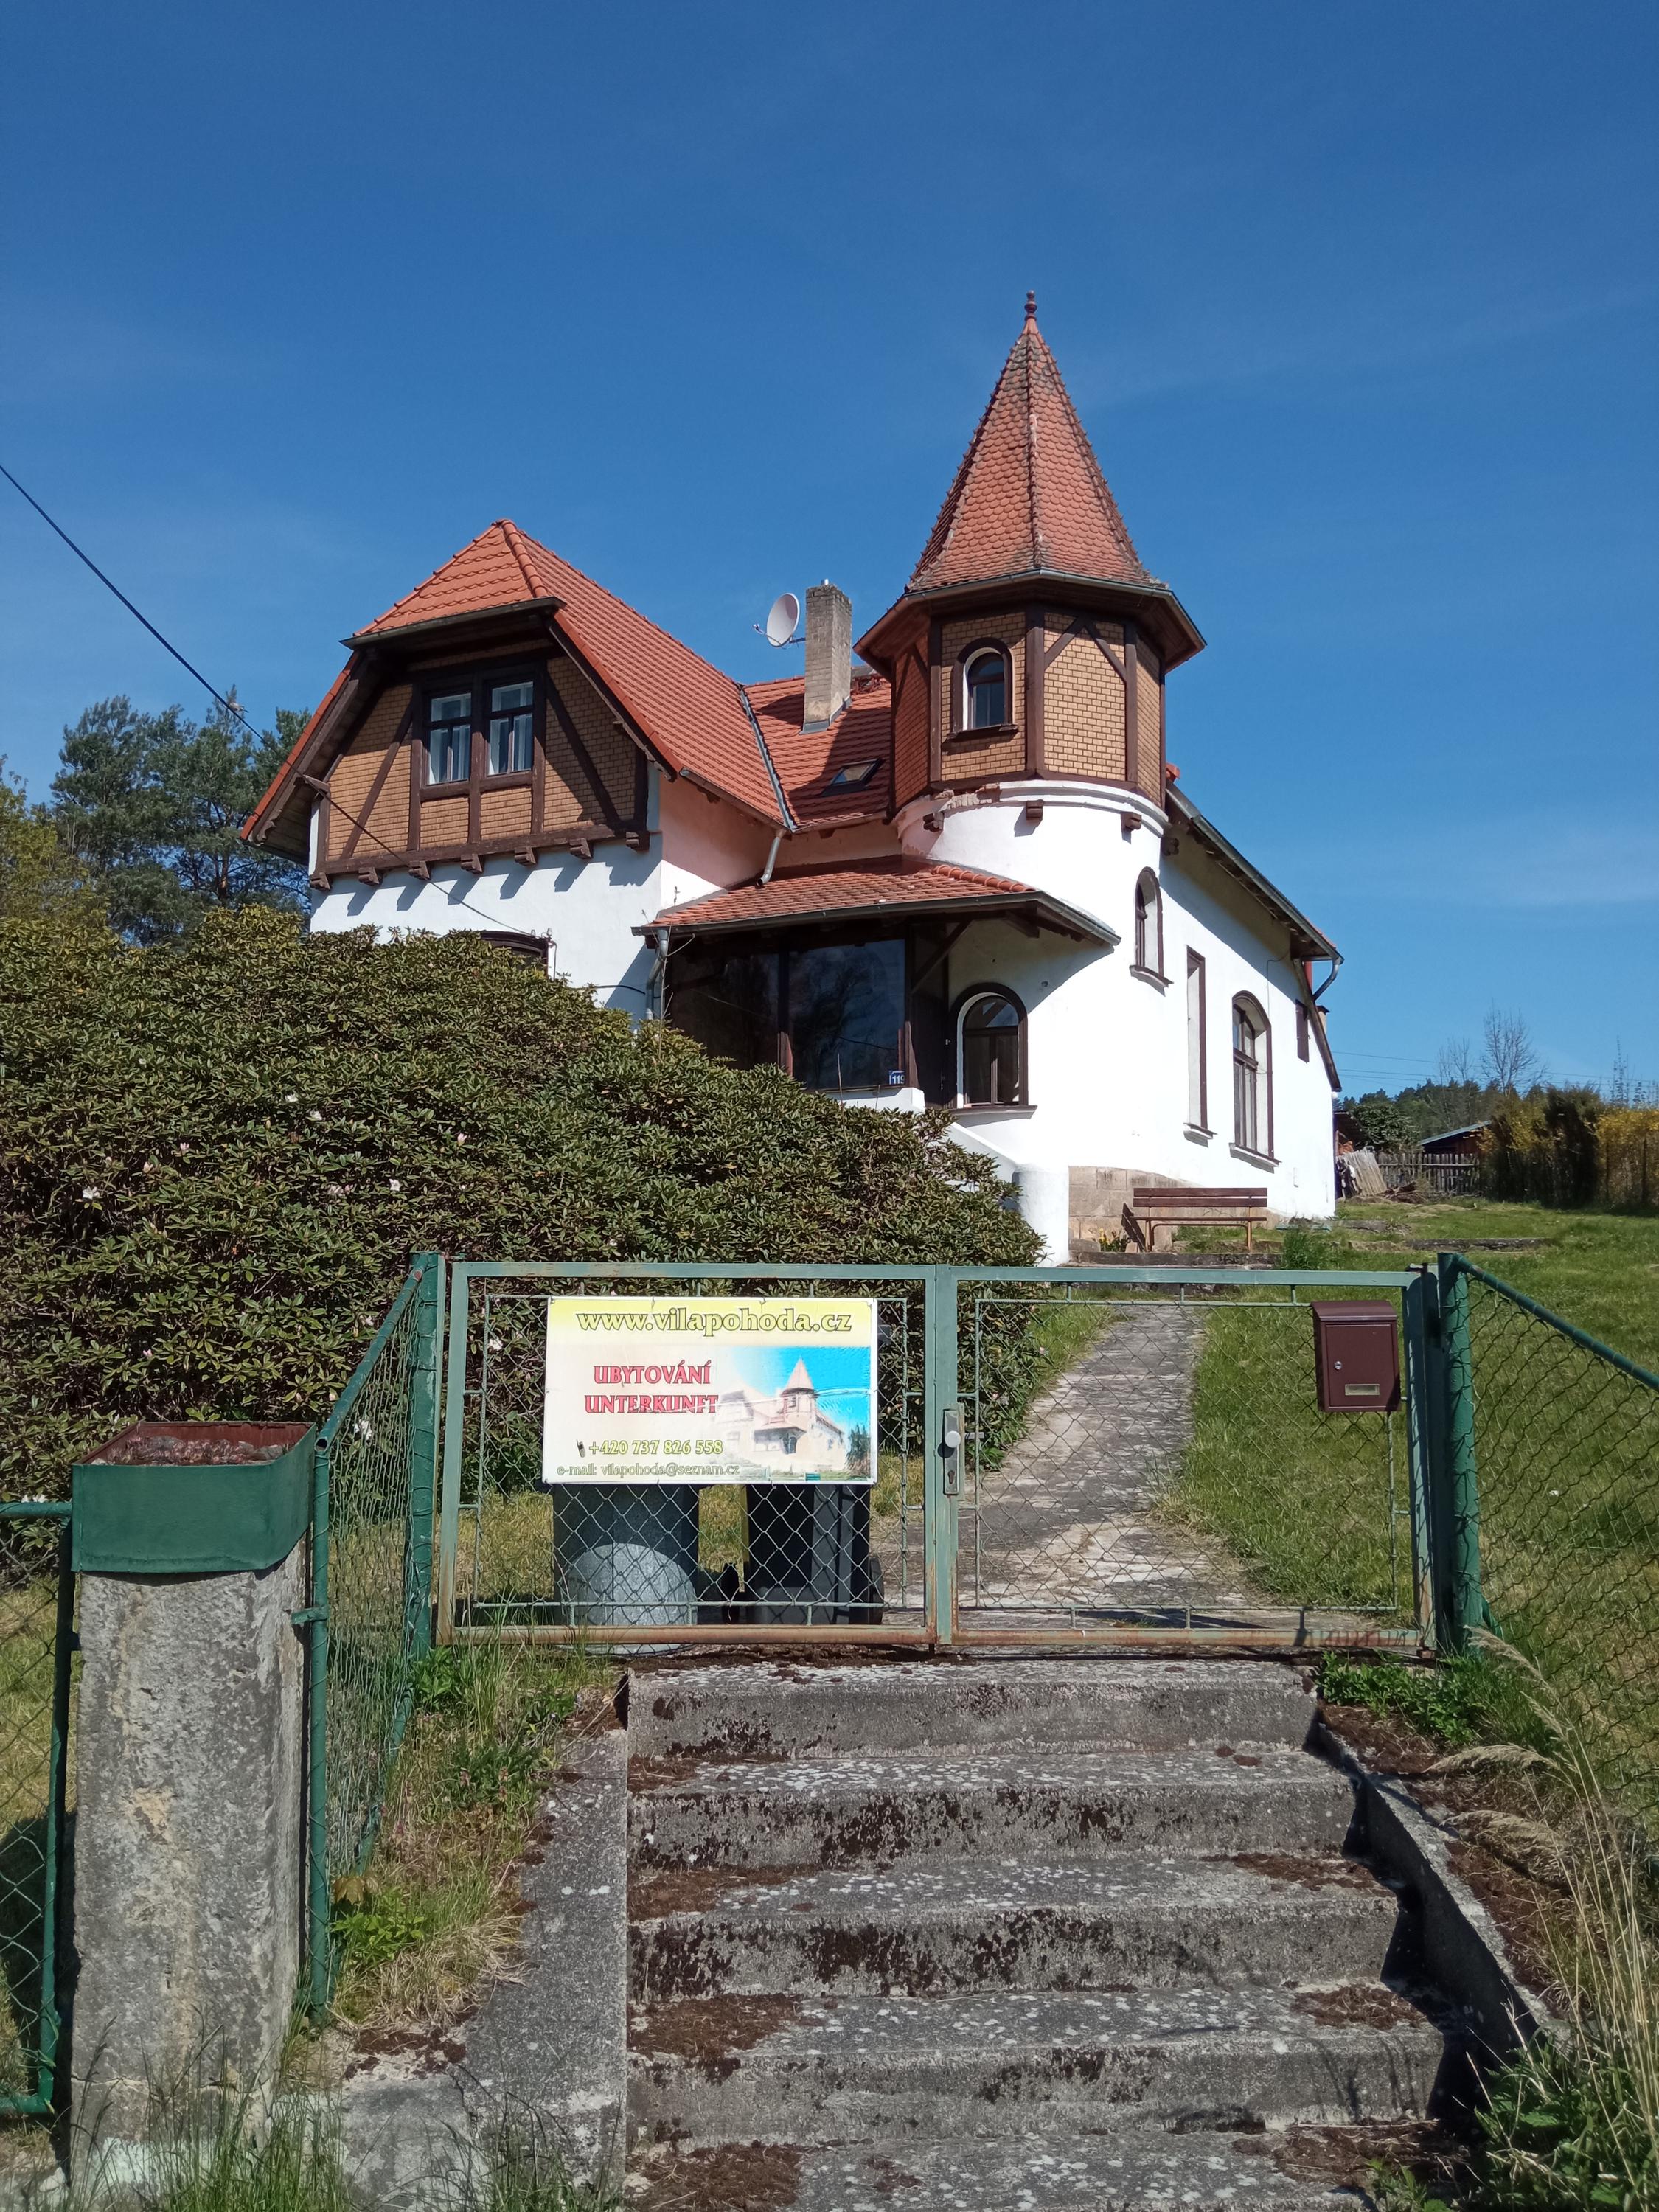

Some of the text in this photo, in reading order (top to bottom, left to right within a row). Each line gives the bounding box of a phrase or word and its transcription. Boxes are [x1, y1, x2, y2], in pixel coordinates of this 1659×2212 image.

[891, 1074, 905, 1085] 119
[576, 1307, 852, 1337] www.vilapohoda.cz
[594, 1359, 712, 1384] UBYTOVÁNÍ
[584, 1394, 719, 1414] UNTERKUNFT
[589, 1440, 723, 1455] +420 737 826 558
[557, 1462, 740, 1478] e-mail: vilapohoda@seznam.cz
